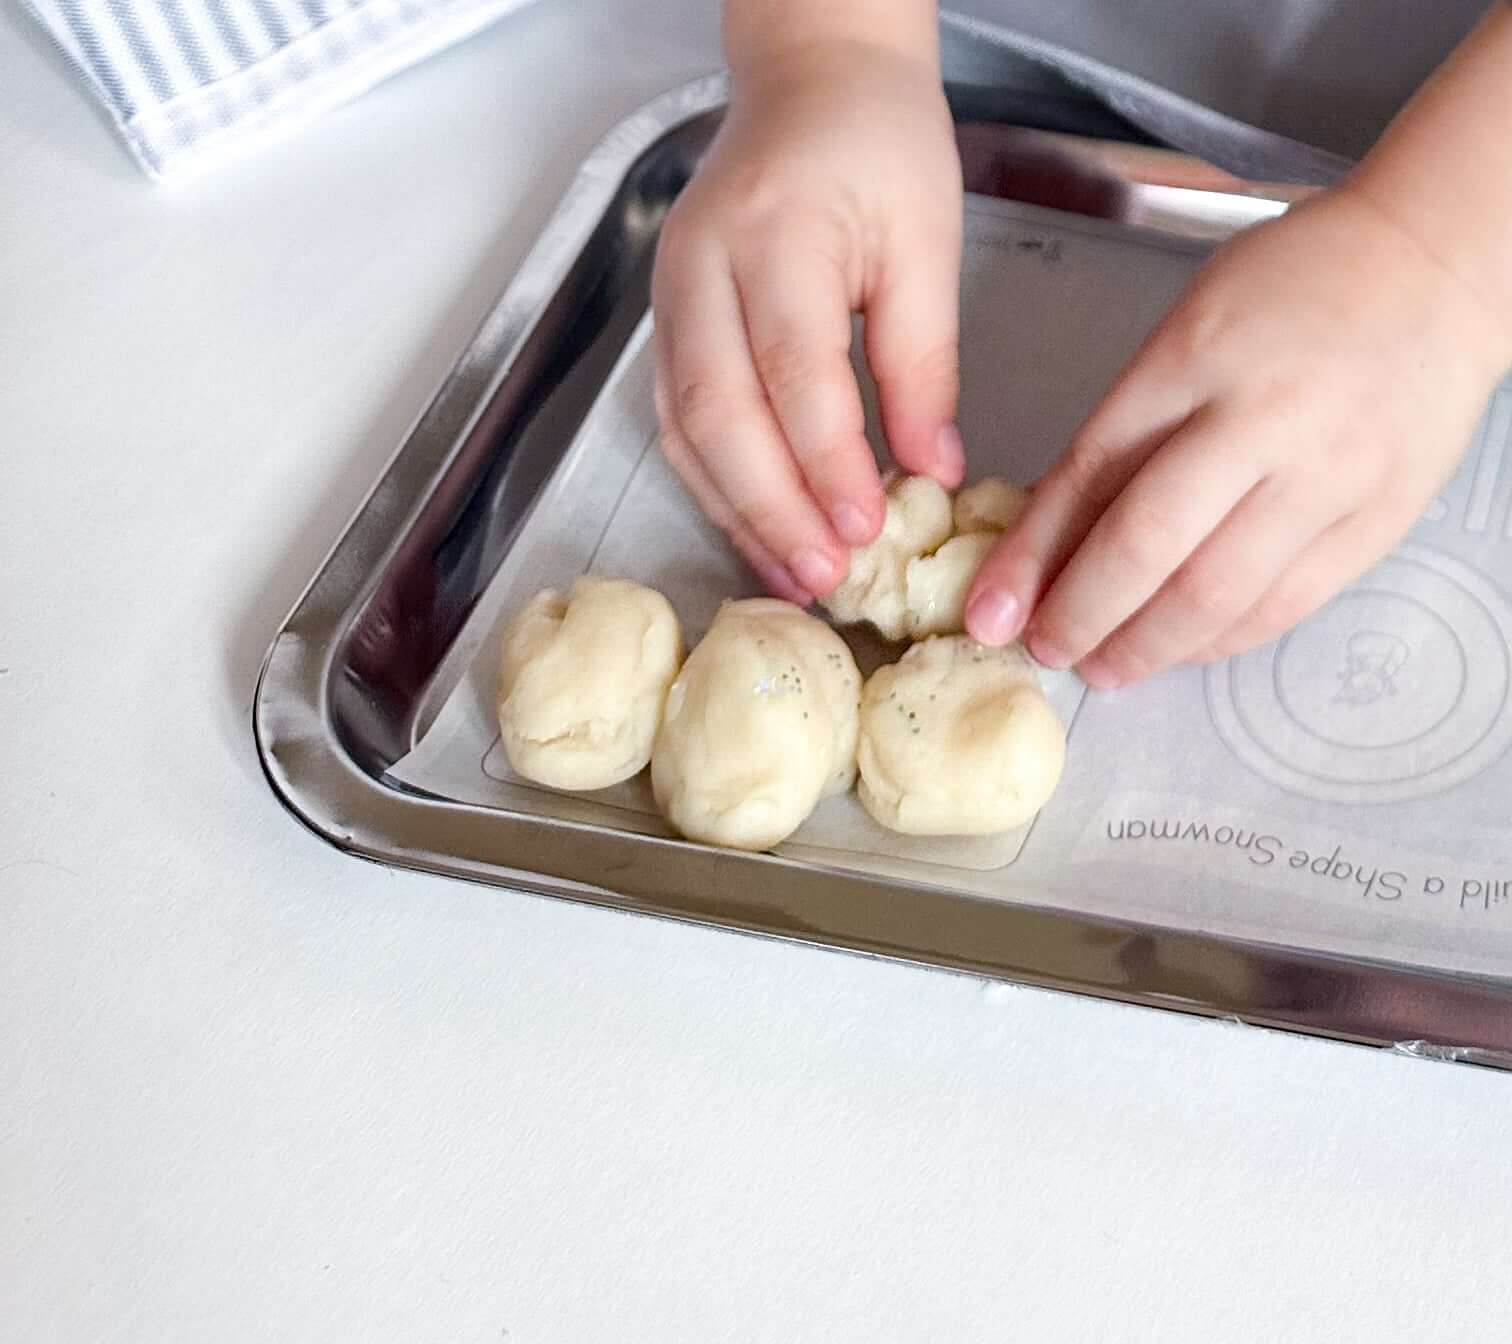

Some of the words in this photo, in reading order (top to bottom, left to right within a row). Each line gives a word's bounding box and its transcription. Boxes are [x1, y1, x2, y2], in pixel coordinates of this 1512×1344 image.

[1106, 818, 1284, 866] Snowman
[1288, 845, 1409, 902] Shape
[1422, 875, 1445, 897] a
